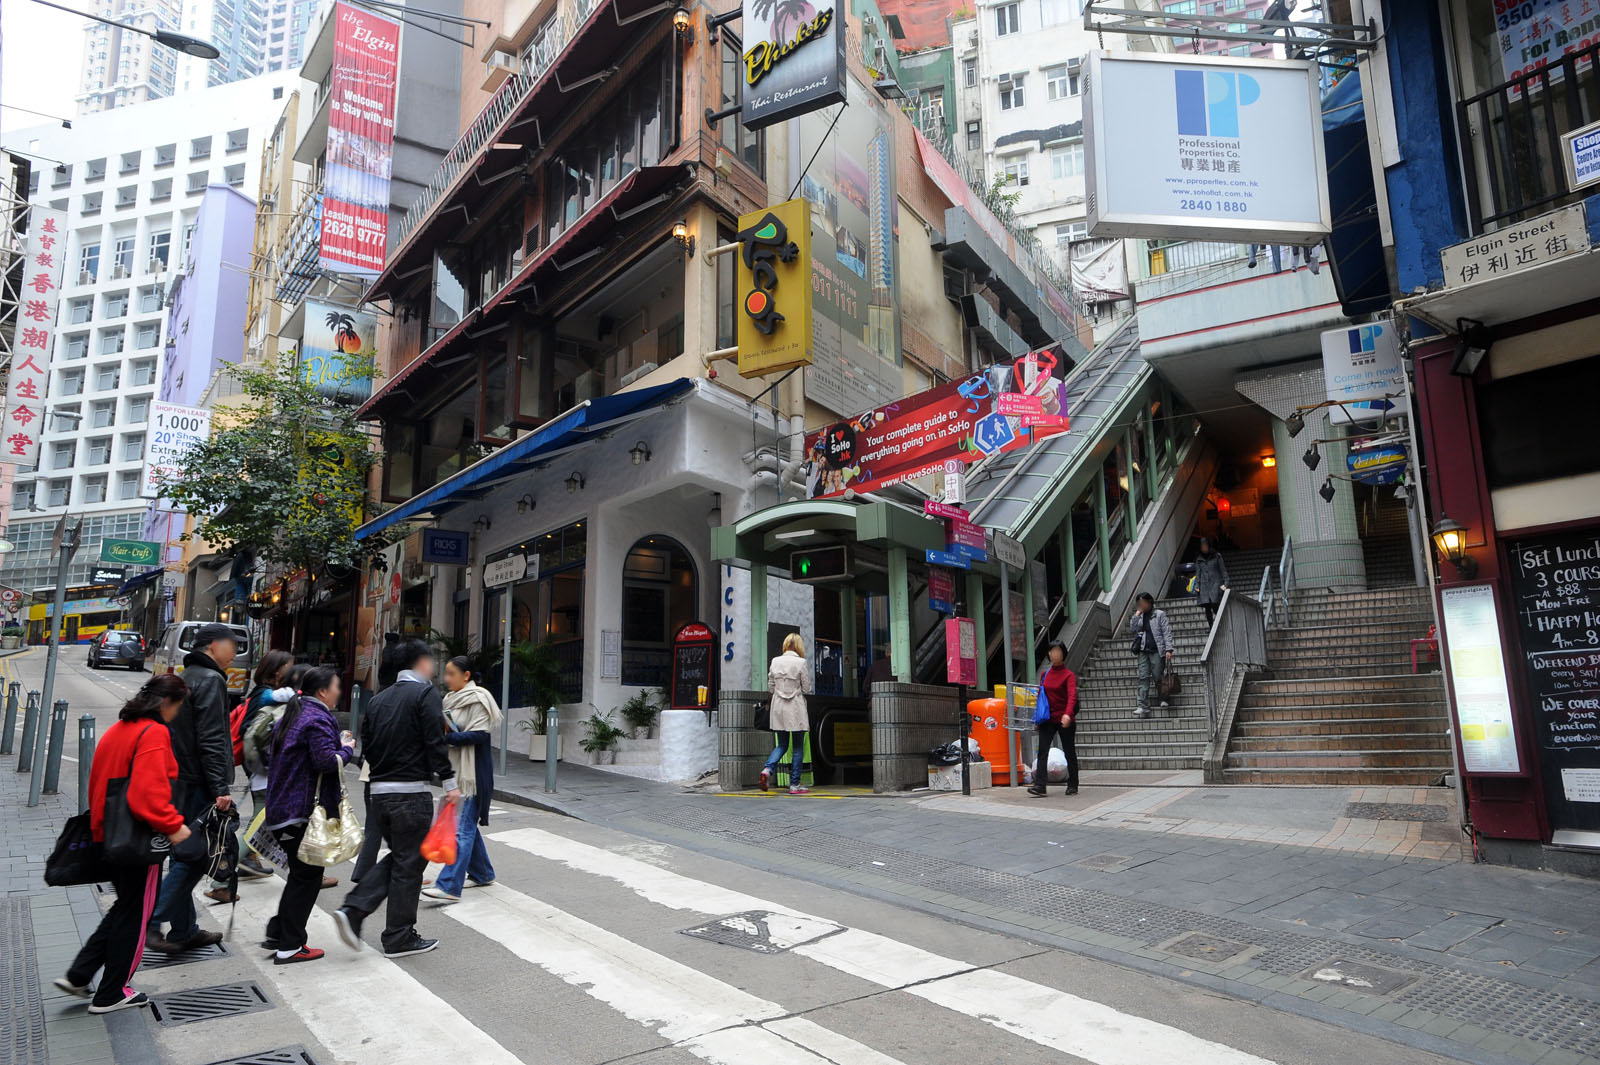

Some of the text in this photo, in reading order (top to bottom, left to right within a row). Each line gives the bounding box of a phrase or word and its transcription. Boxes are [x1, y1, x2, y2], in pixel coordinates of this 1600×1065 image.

[341, 11, 364, 27] the
[352, 26, 396, 52] Elgin
[1521, 39, 1552, 63] For
[344, 89, 384, 111] Welcome
[751, 76, 828, 110] Thai Restaurant
[331, 99, 393, 128] to Stay with us
[1179, 138, 1241, 150] Professional
[1179, 148, 1241, 158] Properties Co.
[1576, 151, 1593, 165] Centre
[1180, 158, 1241, 173] 專業地產
[1165, 177, 1260, 188] www.pproperties.com.hk
[1172, 189, 1254, 198] www.sohoflat.com.hk
[1180, 199, 1248, 213] 2840 1880
[324, 207, 382, 232] Leasing Hotline
[324, 218, 387, 247] 2626 9777
[1465, 220, 1556, 258] Elgin Street
[1459, 233, 1569, 284] 伊利近街
[6, 217, 59, 457] 基督教香港潮人生命堂
[1334, 373, 1362, 384] Come
[1365, 371, 1374, 379] in
[157, 413, 203, 431] 1,000'
[866, 410, 959, 447] Your complete guide to
[831, 441, 851, 454] SoHo
[860, 420, 970, 463] everything going on in SoHo
[1523, 549, 1552, 569] Set
[1535, 572, 1548, 588] 3
[1556, 582, 1581, 597] $88
[1537, 614, 1581, 632] HAPPY
[1533, 657, 1587, 670] WEEKEND
[1551, 670, 1575, 680] every
[1568, 699, 1600, 710] COVER
